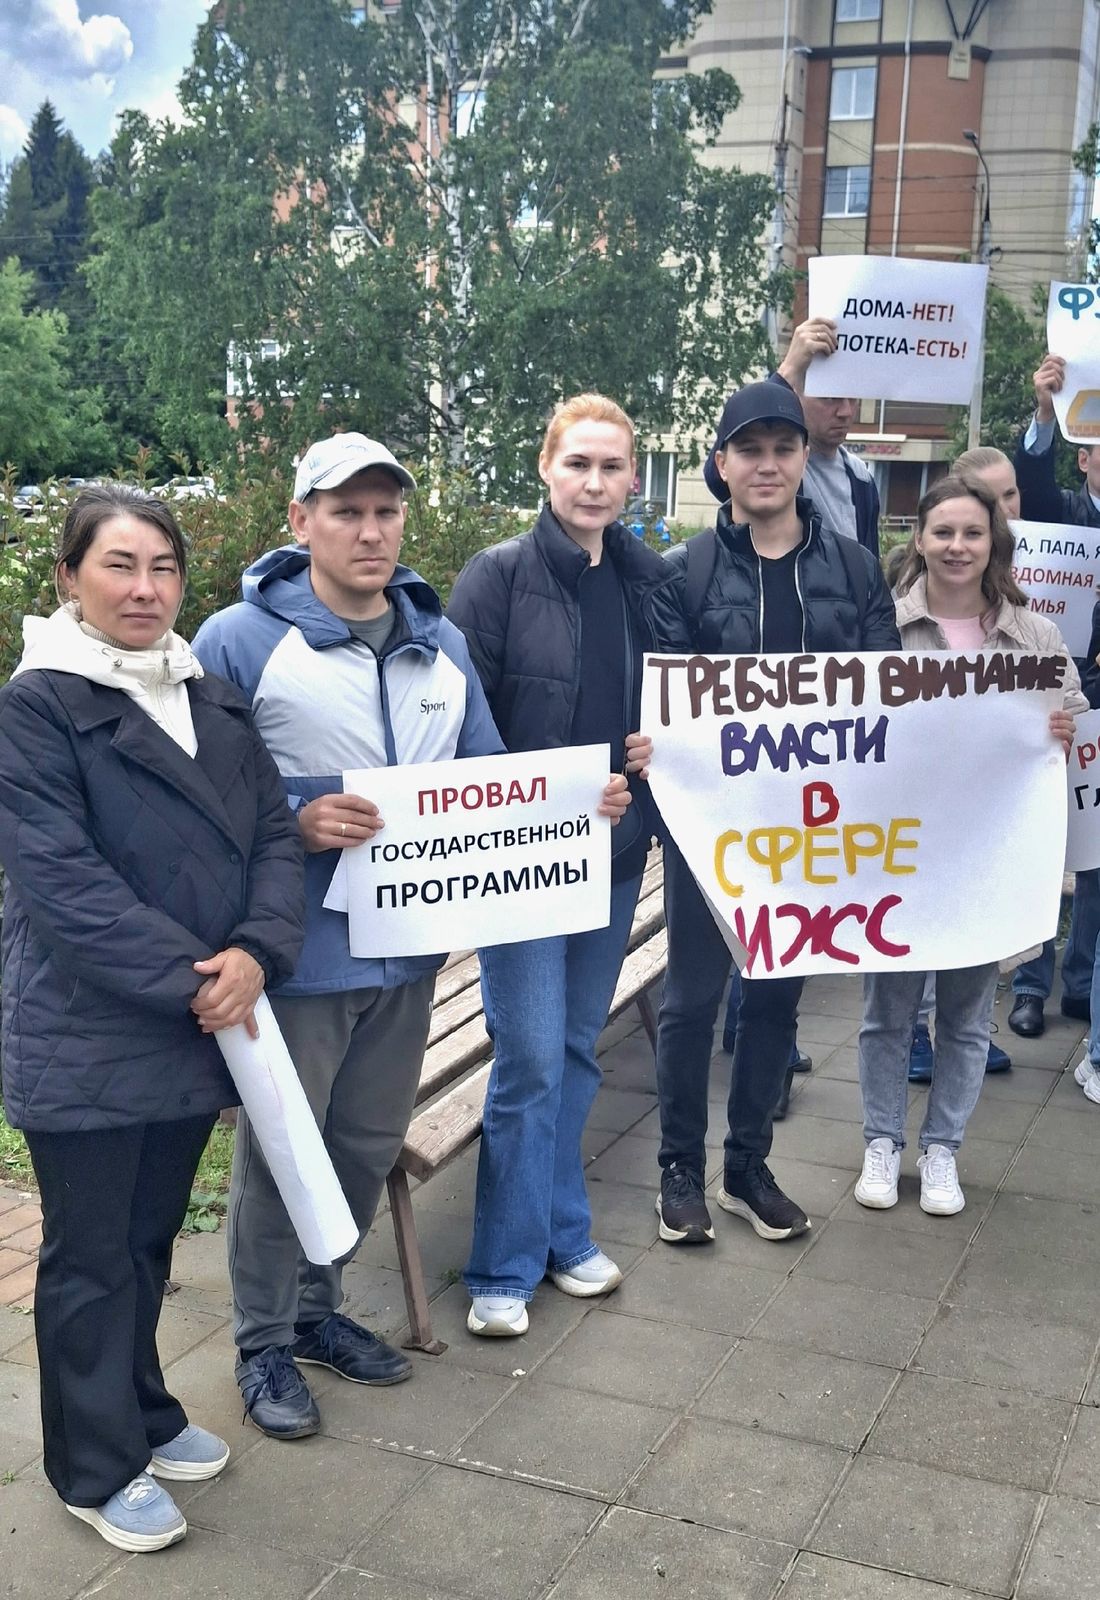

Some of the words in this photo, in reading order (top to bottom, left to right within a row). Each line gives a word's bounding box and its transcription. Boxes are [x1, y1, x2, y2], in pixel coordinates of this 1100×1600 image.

[843, 298, 954, 322] ДОМА-НЕТ!
[1058, 286, 1100, 320] Ф
[836, 333, 967, 359] ПОТЕКА-ЕСТЬ!
[1040, 539, 1090, 560] ПАПА,
[420, 698, 446, 715] Sport
[647, 655, 865, 726] ТРЕБУЕМ
[878, 653, 1067, 706] ВНИМАНИЕ
[721, 715, 889, 776] ВЛАСТИ
[418, 776, 547, 815] ПРОВАЛ
[802, 781, 840, 828] В
[370, 815, 591, 863] ГОСУДАРСТВЕННОЙ
[714, 818, 922, 898] СФЕРЕ
[376, 858, 588, 909] ПРОГРАММЫ
[735, 894, 911, 977] ИЖС
